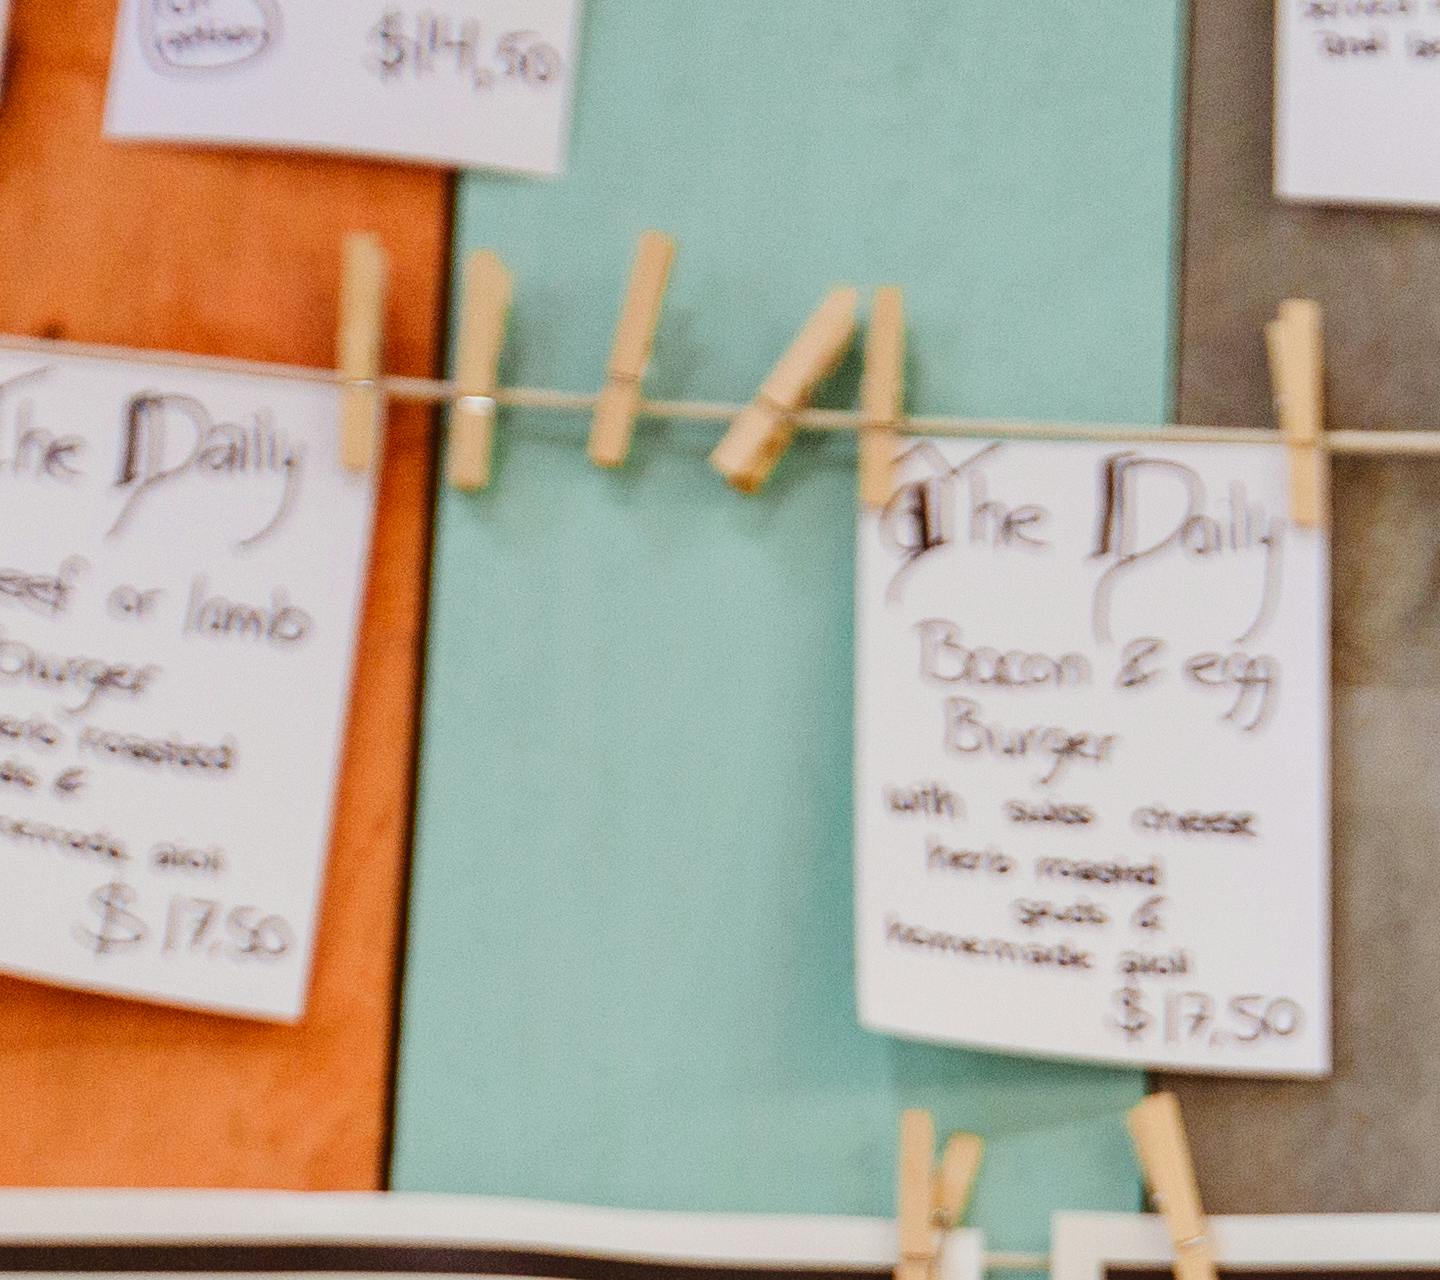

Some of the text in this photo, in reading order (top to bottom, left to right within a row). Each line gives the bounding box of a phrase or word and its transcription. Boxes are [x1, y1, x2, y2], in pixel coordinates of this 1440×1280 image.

[110, 389, 303, 545] Daily
[882, 443, 1285, 640] The Daily
[109, 585, 159, 617] or
[187, 578, 311, 643] lamb
[917, 620, 1277, 729] Bacon & egg
[81, 727, 237, 769] roasted
[946, 698, 1116, 782] Burger
[887, 783, 963, 817] with
[1134, 807, 1255, 835] cheese
[927, 836, 1162, 885] herb roasted
[75, 884, 291, 957] $17.50
[886, 914, 1093, 968] homemade
[1108, 988, 1302, 1044] $17.50
